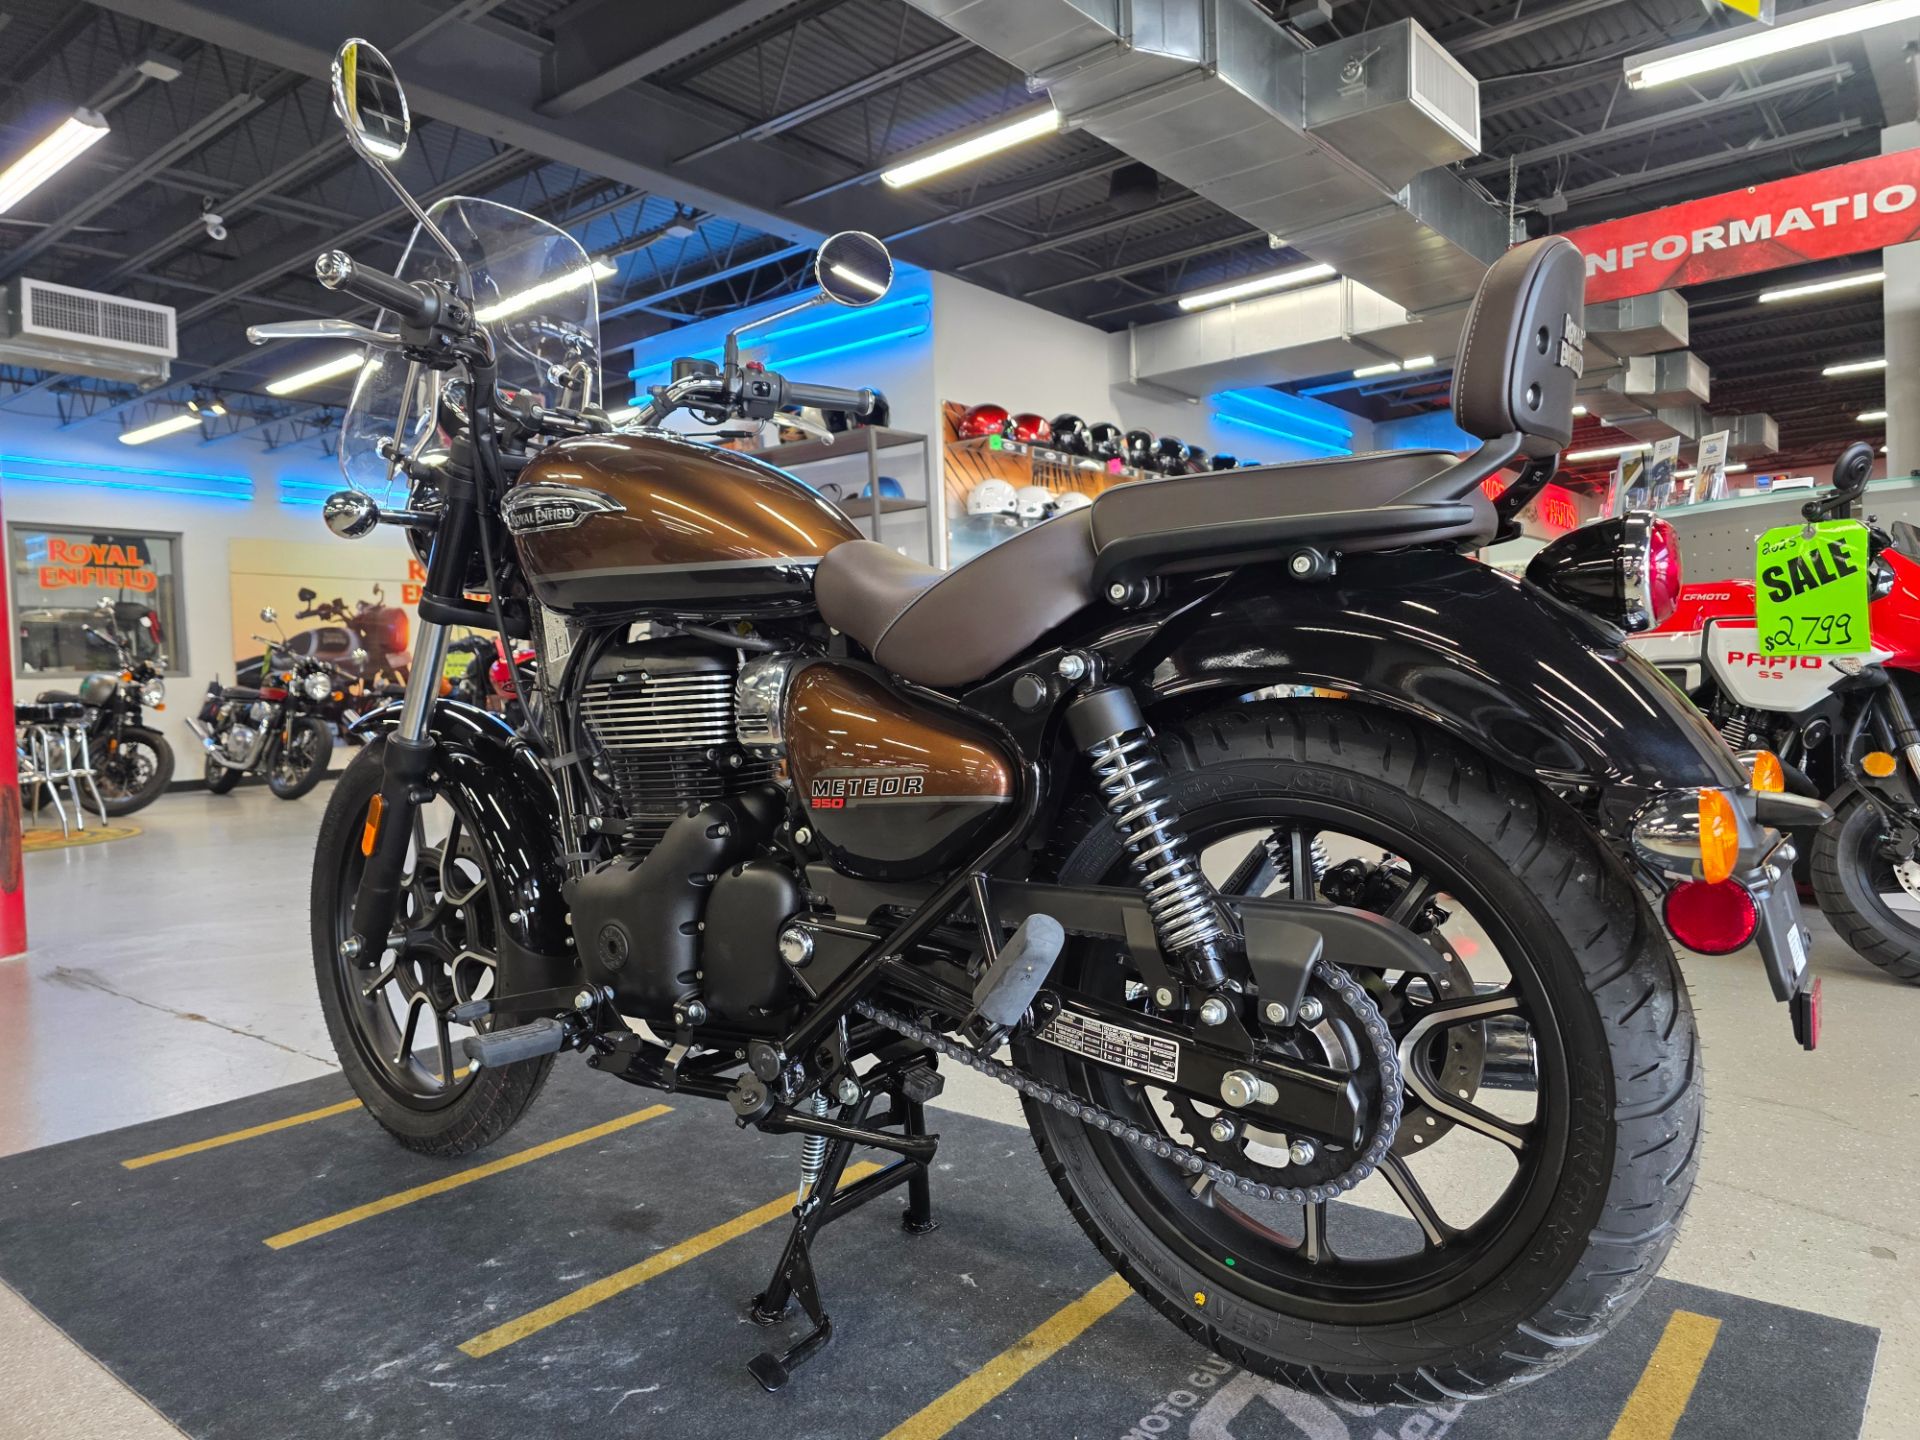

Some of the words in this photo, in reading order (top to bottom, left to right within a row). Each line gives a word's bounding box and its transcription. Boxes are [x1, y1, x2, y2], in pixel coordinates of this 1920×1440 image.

[535, 506, 576, 524] ENFIELD
[48, 538, 144, 567] ROYAL
[39, 566, 158, 593] ENFIELD
[1762, 537, 1858, 603] SALE
[1682, 592, 1731, 602] CFMOTO
[1728, 651, 1823, 671] PAPIO
[1759, 670, 1784, 680] SS
[811, 776, 925, 797] METEOR
[811, 798, 846, 809] 350
[1187, 1354, 1234, 1389] GU
